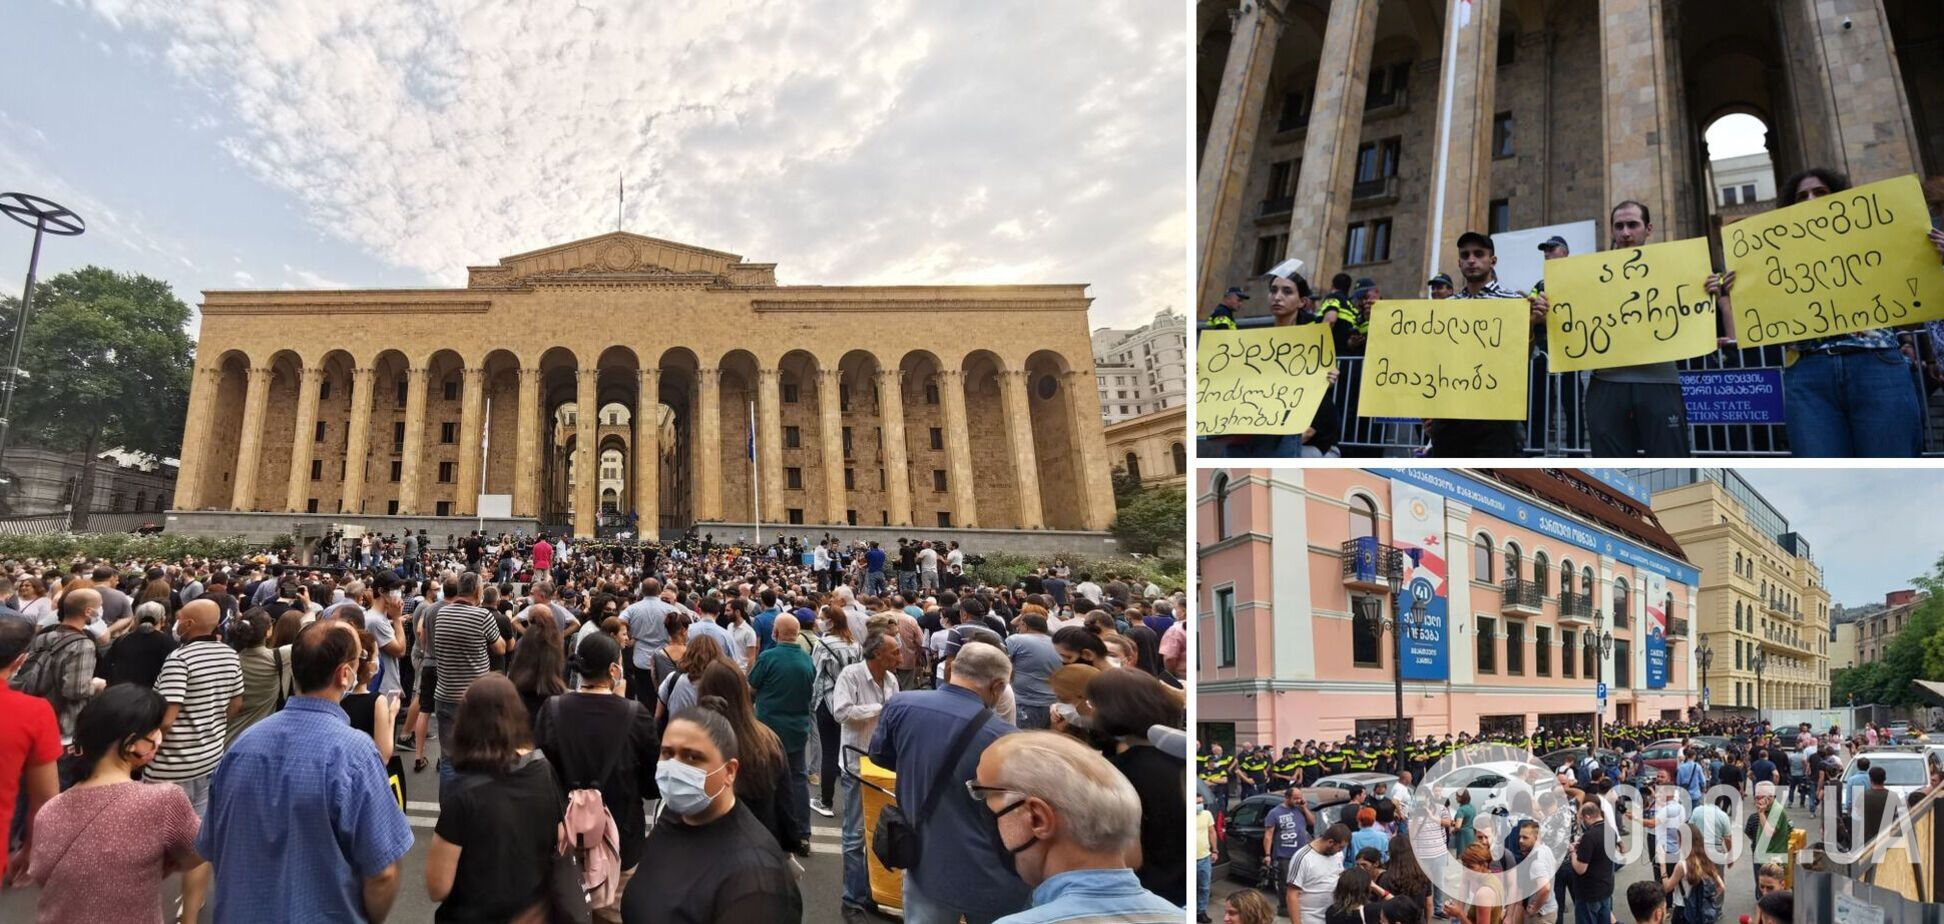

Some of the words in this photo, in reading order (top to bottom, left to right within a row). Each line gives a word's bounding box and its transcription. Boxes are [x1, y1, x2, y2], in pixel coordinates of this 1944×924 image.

[1733, 193, 1894, 257] გადადგეს
[1599, 249, 1649, 283] არ
[1766, 250, 1882, 294] მკვლელი
[1390, 308, 1503, 349] მოძალადე
[1745, 277, 1921, 343] მთავრობა!
[1207, 333, 1334, 377] გადადგეს
[1196, 377, 1304, 410] მოძალადე
[1375, 357, 1498, 399] მთავრობა
[1713, 401, 1751, 410] STATE
[1721, 410, 1770, 420] SERVICE
